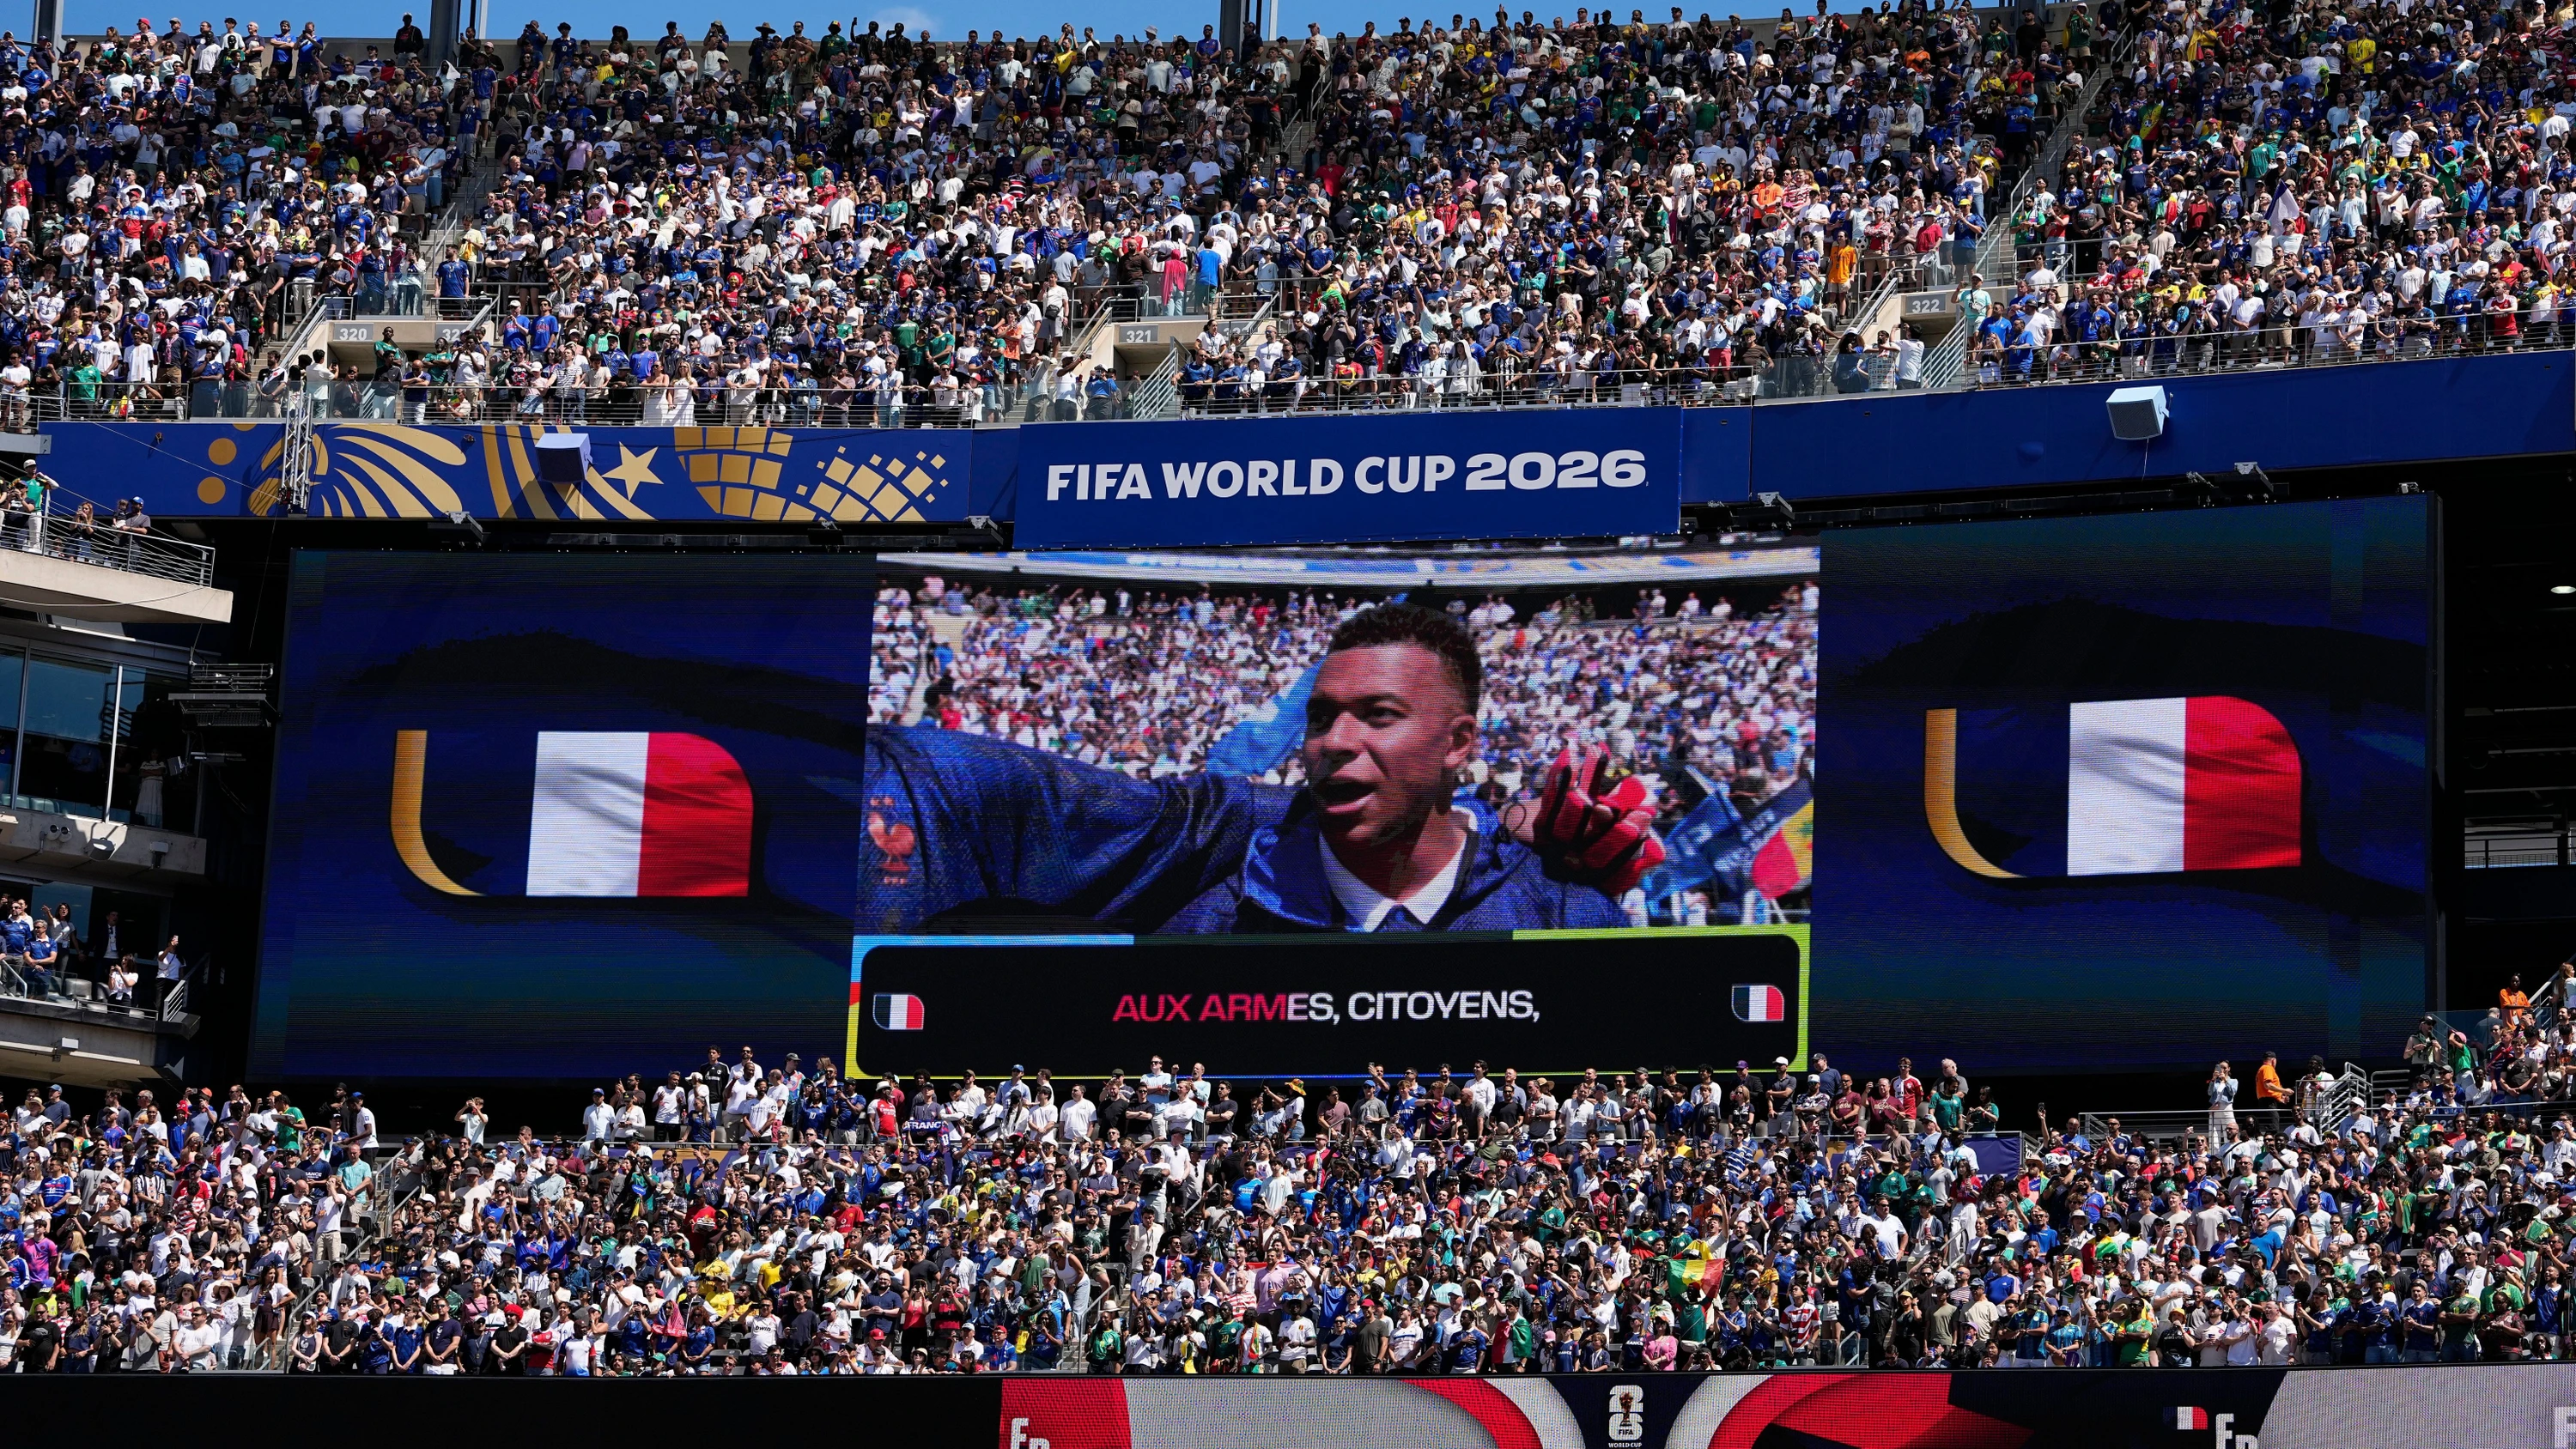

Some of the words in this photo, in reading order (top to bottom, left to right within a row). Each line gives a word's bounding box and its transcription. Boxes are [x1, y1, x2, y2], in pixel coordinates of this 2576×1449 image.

[1912, 300, 1940, 313] 322
[340, 328, 367, 341] 320
[1127, 330, 1151, 343] 321
[1047, 463, 1152, 501] FIFA
[1161, 458, 1344, 499] WORLD
[1354, 455, 1455, 494] CUP
[1465, 449, 1646, 491] 2026
[1113, 994, 1192, 1022] AUX
[1199, 992, 1340, 1025] ARMES,
[1347, 990, 1540, 1023] CITOYENS,
